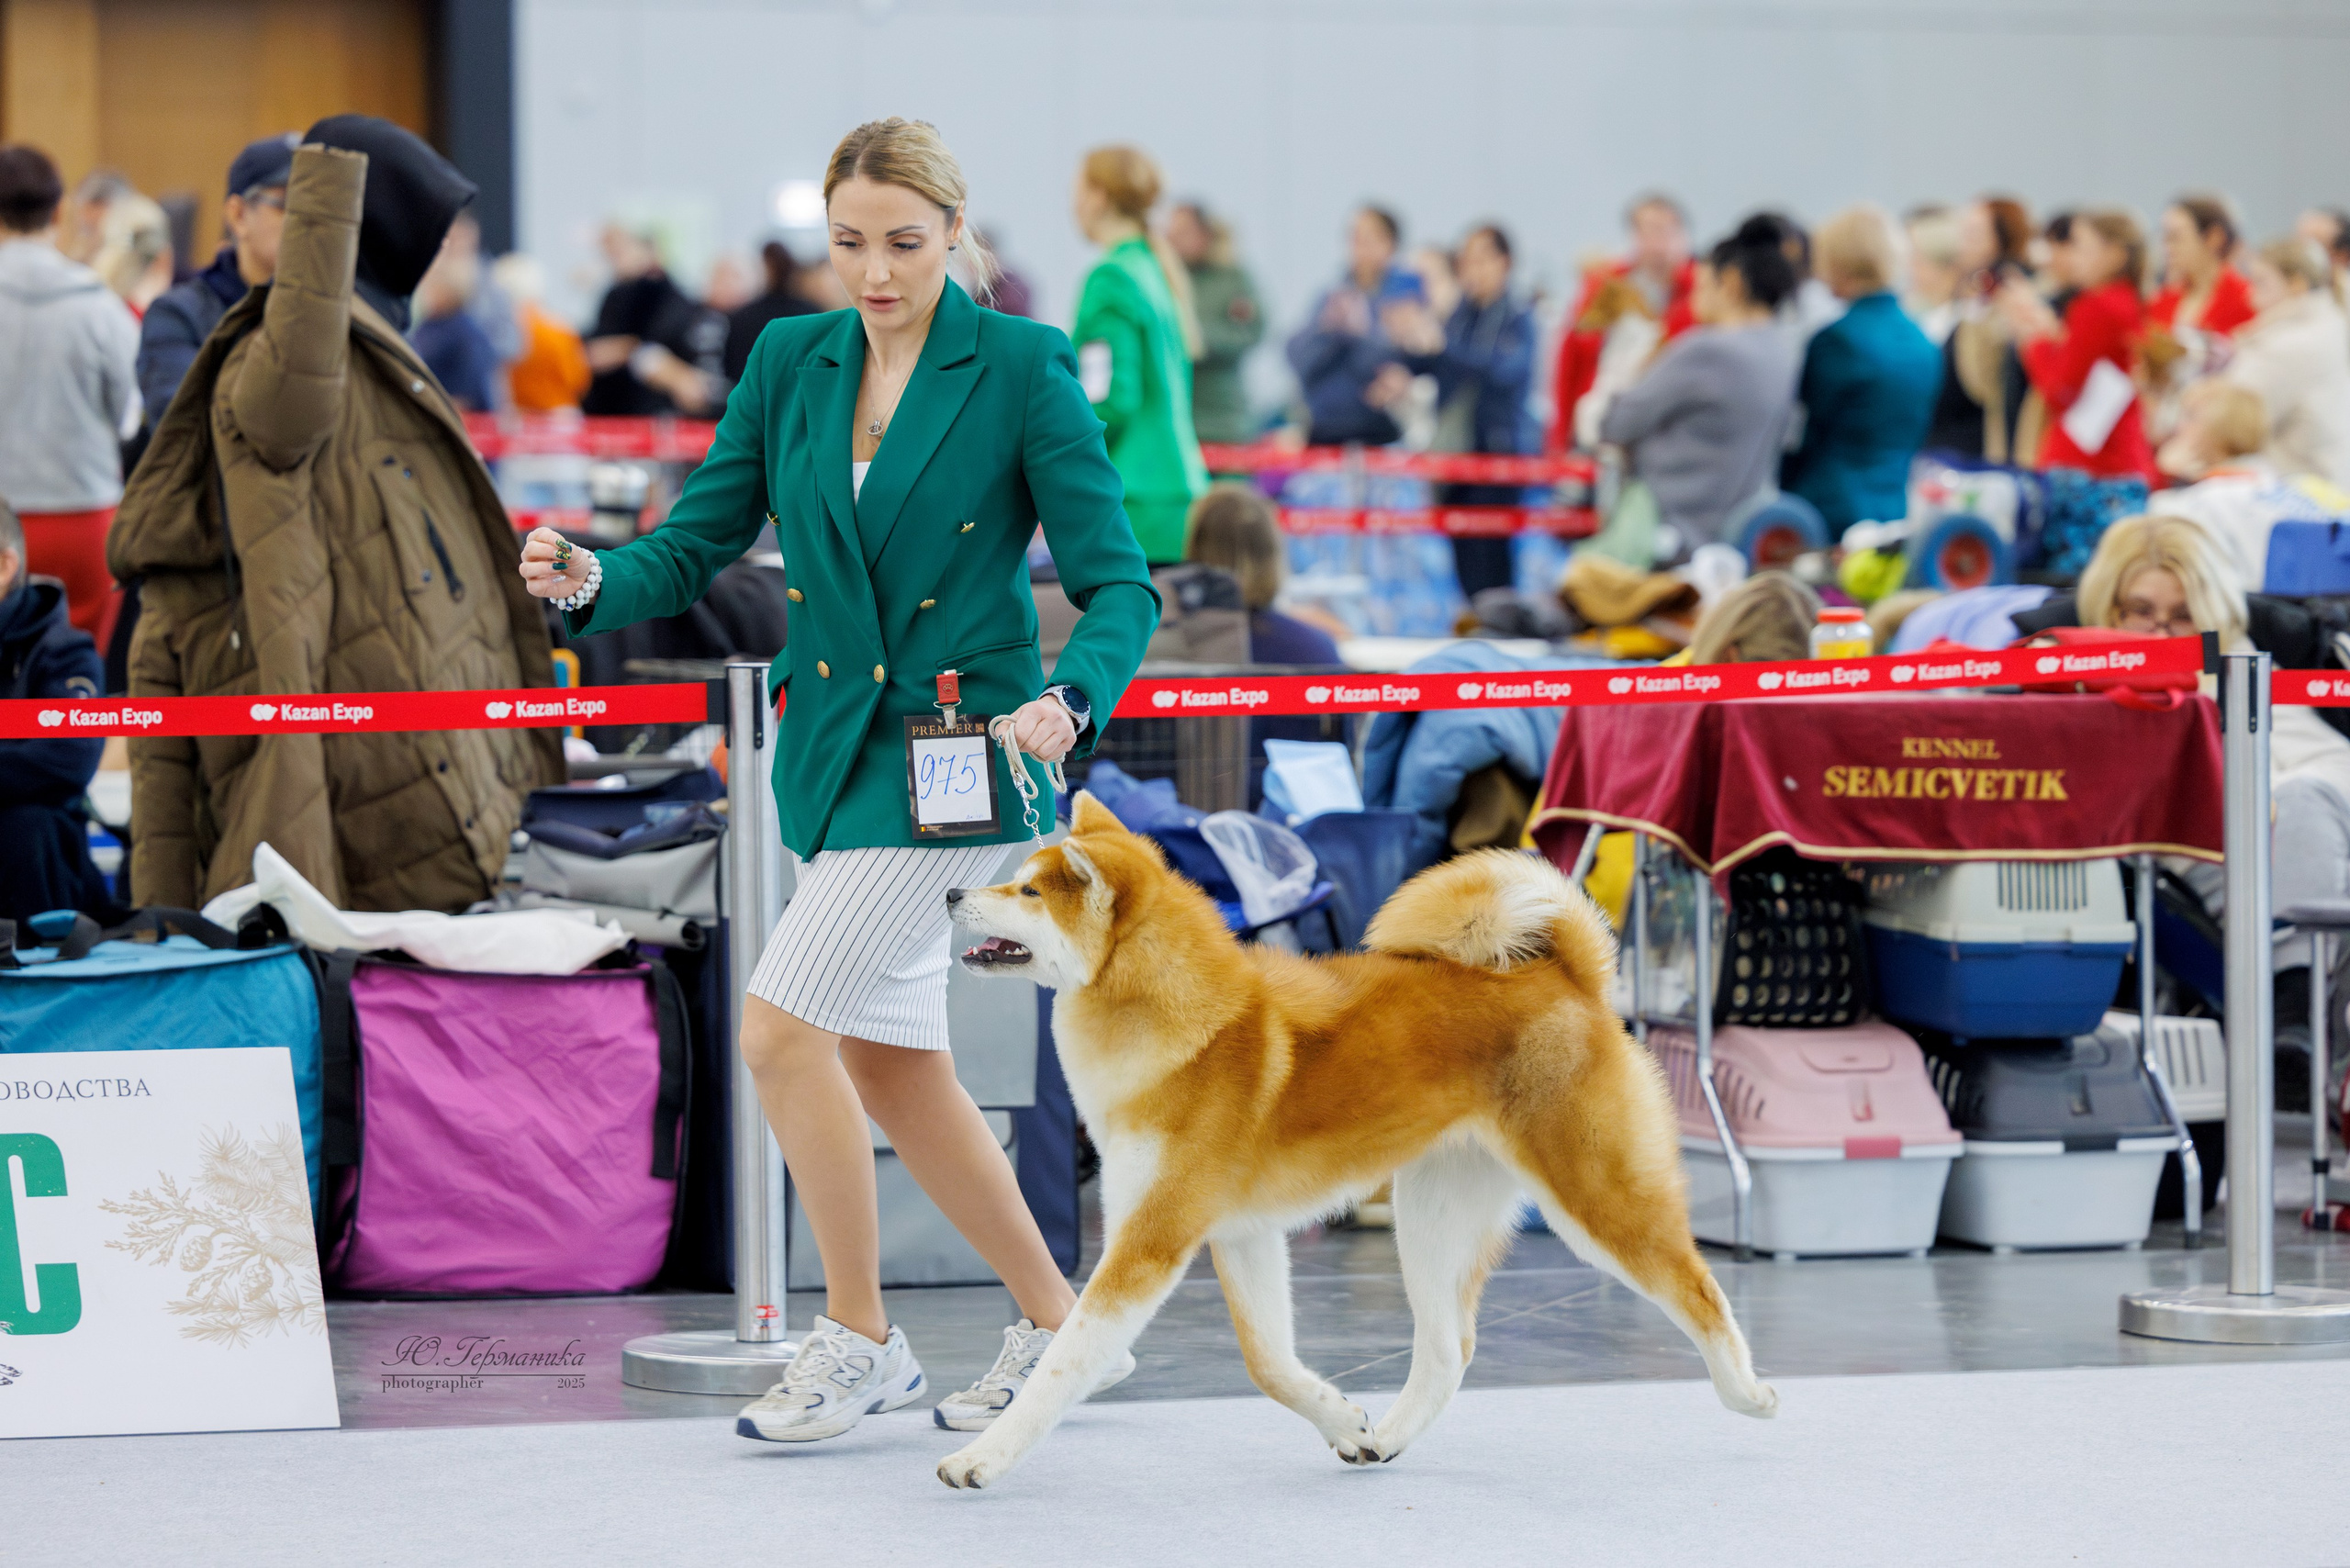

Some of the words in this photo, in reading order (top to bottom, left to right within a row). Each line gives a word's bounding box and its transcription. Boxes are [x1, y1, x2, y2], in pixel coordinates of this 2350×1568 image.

[1917, 663, 1964, 681] Kazan
[1964, 659, 2002, 679] Expo
[2062, 654, 2109, 672] Kazan
[2109, 650, 2146, 671] Expo
[1635, 676, 1683, 693] Kazan
[1683, 672, 1721, 694] Expo
[1785, 670, 1832, 689] Kazan
[1832, 666, 1871, 688] Expo
[1181, 689, 1229, 708] Kazan
[1229, 687, 1270, 709] Expo
[1333, 685, 1381, 703] Kazan
[1381, 684, 1421, 706] Expo
[1484, 681, 1532, 700] Kazan
[1533, 679, 1572, 701] Expo
[69, 709, 119, 727] Kazan
[121, 707, 163, 729] Expo
[280, 703, 330, 722] Kazan
[332, 702, 374, 724] Expo
[515, 700, 565, 719] Kazan
[565, 698, 607, 719] Expo
[1901, 736, 2001, 760] KENNEL
[921, 753, 984, 800] 975
[1822, 765, 2069, 801] SEMICVETIK
